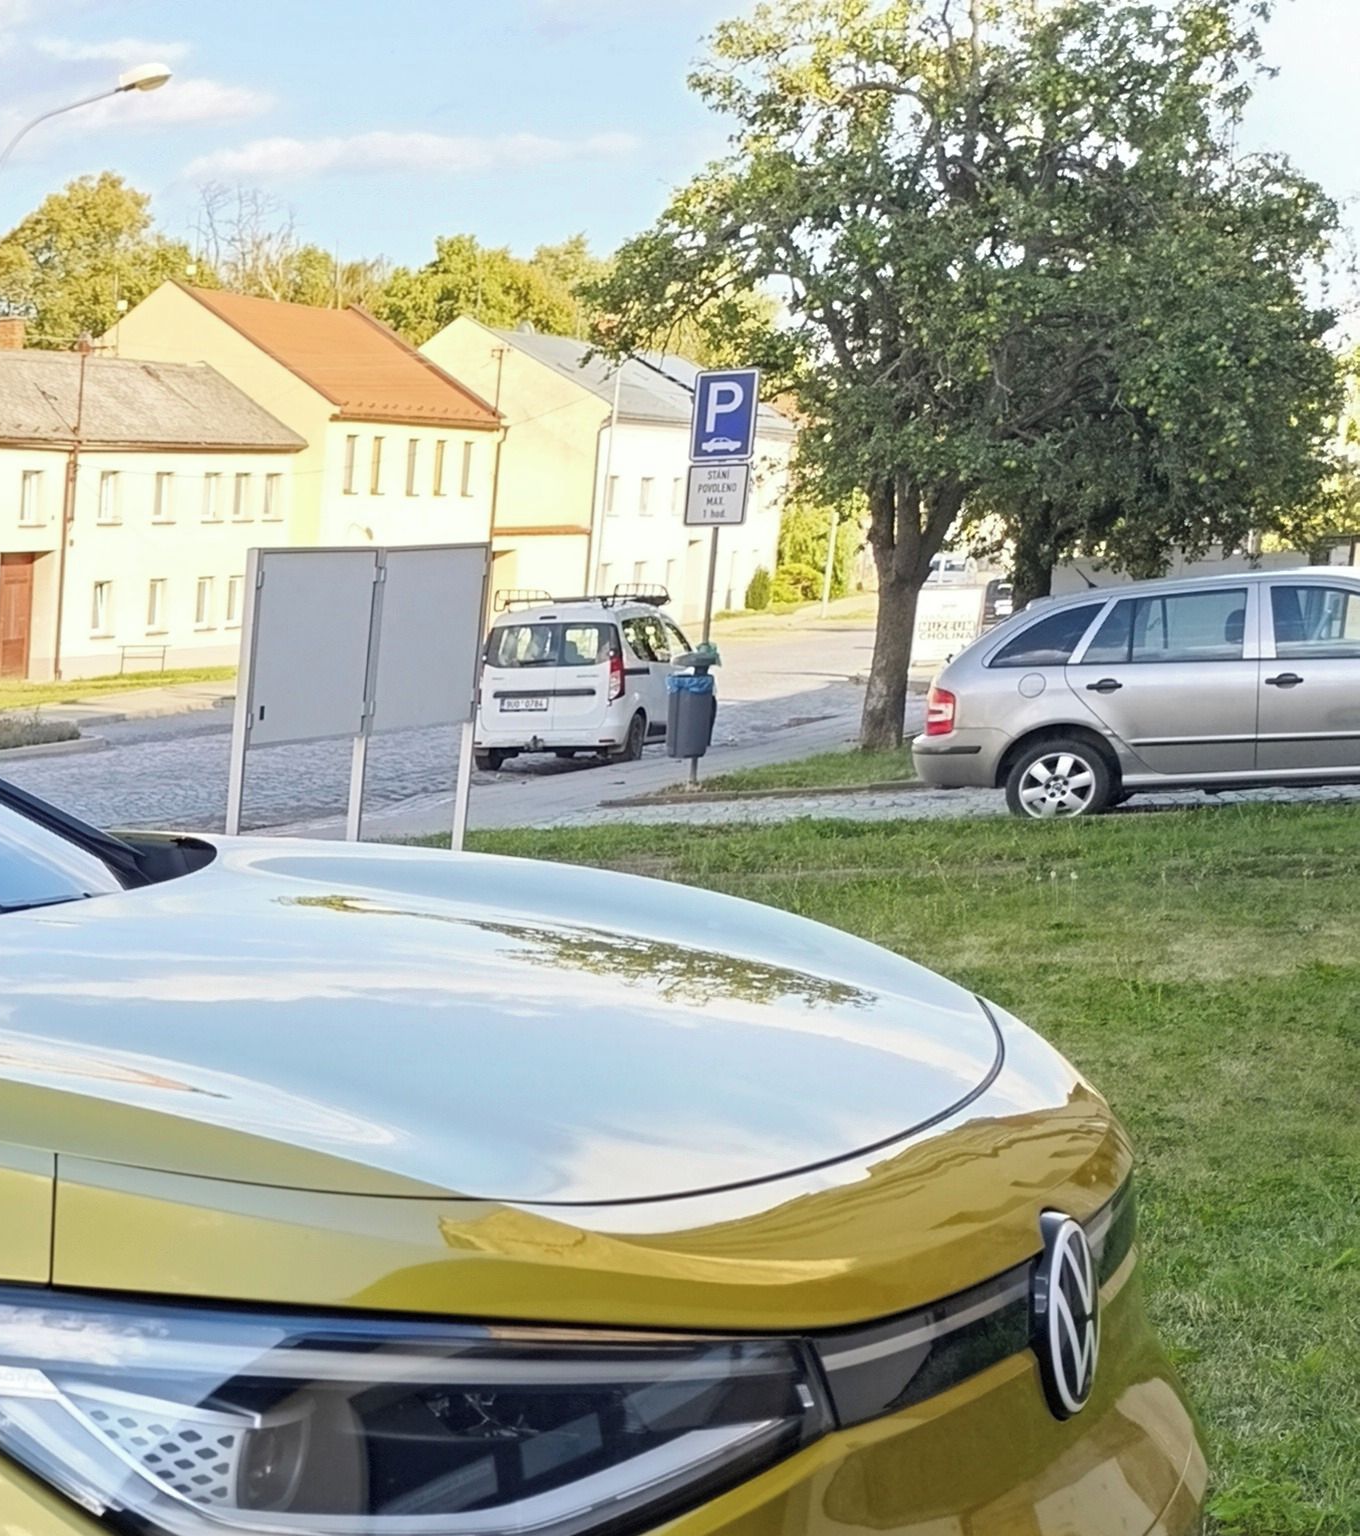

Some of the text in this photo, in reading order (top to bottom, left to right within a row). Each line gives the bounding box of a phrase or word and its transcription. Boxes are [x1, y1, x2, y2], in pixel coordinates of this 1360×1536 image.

[705, 380, 744, 433] P
[707, 469, 730, 480] STÁNÍ
[697, 482, 738, 494] POVOLENO
